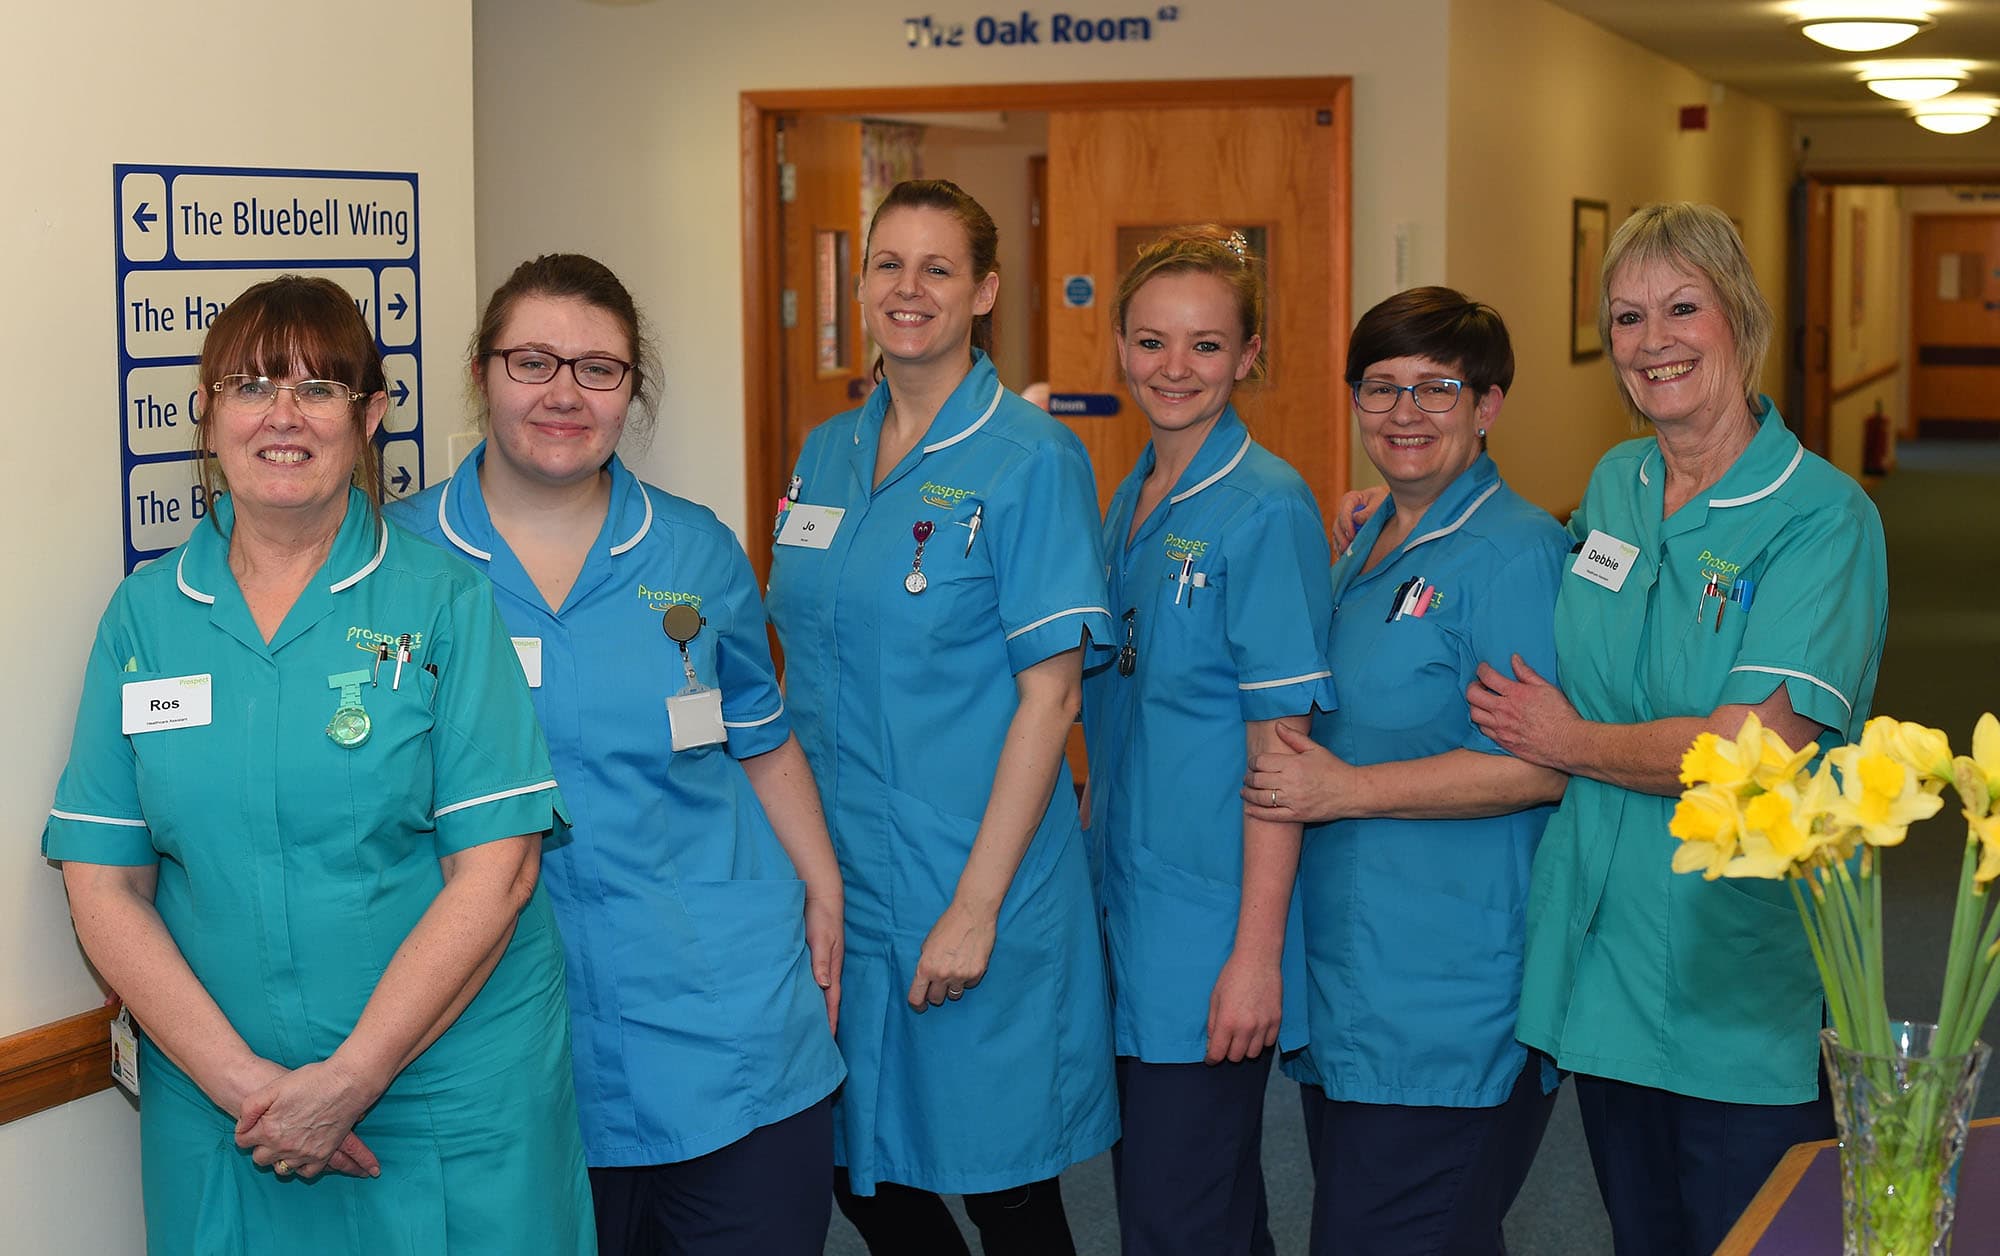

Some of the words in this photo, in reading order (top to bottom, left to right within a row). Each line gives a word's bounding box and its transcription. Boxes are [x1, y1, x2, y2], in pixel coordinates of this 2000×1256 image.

[975, 11, 1039, 45] Oak
[1052, 14, 1151, 42] Room
[181, 202, 222, 235] The
[234, 198, 338, 235] Bluebell
[349, 202, 408, 245] Wing
[131, 298, 174, 332] The
[134, 395, 177, 428] The
[137, 490, 180, 525] The
[803, 521, 815, 531] Jo
[1163, 533, 1209, 552] Prospec
[1588, 549, 1619, 570] Debbie
[638, 584, 702, 607] Prospect
[346, 626, 423, 646] Prospet
[150, 699, 180, 711] Ros
